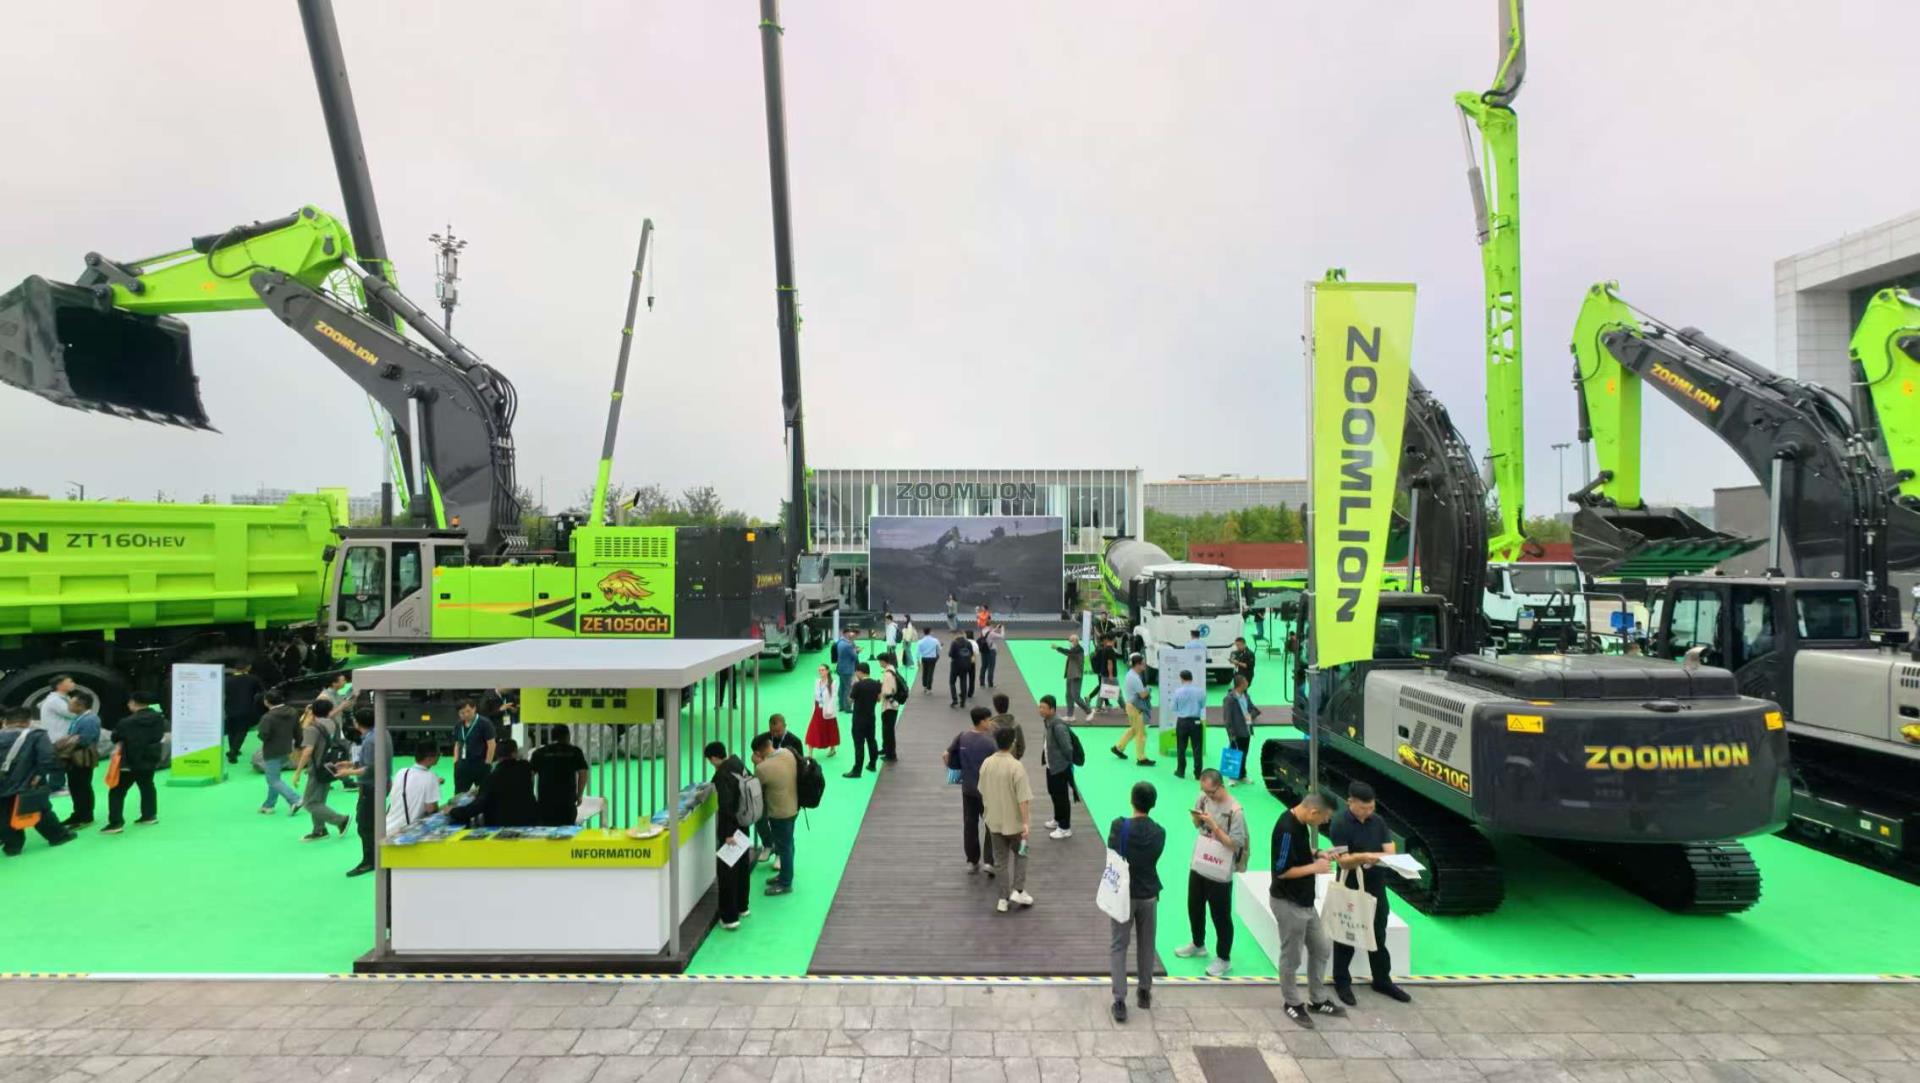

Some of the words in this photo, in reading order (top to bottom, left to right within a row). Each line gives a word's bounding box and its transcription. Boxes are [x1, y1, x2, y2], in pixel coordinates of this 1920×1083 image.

[314, 320, 379, 366] ZOOMLION
[1650, 362, 1722, 411] ZOOMLION
[1336, 326, 1381, 623] ZOOMLION
[897, 482, 1036, 500] ZOOMLION
[66, 533, 185, 548] ZT160HEV
[582, 616, 669, 634] ZE1050GH
[1584, 742, 1751, 771] ZOOMLION
[1420, 756, 1469, 792] ZE210G
[571, 848, 651, 859] INFORMATION
[1203, 853, 1224, 865] SANY
